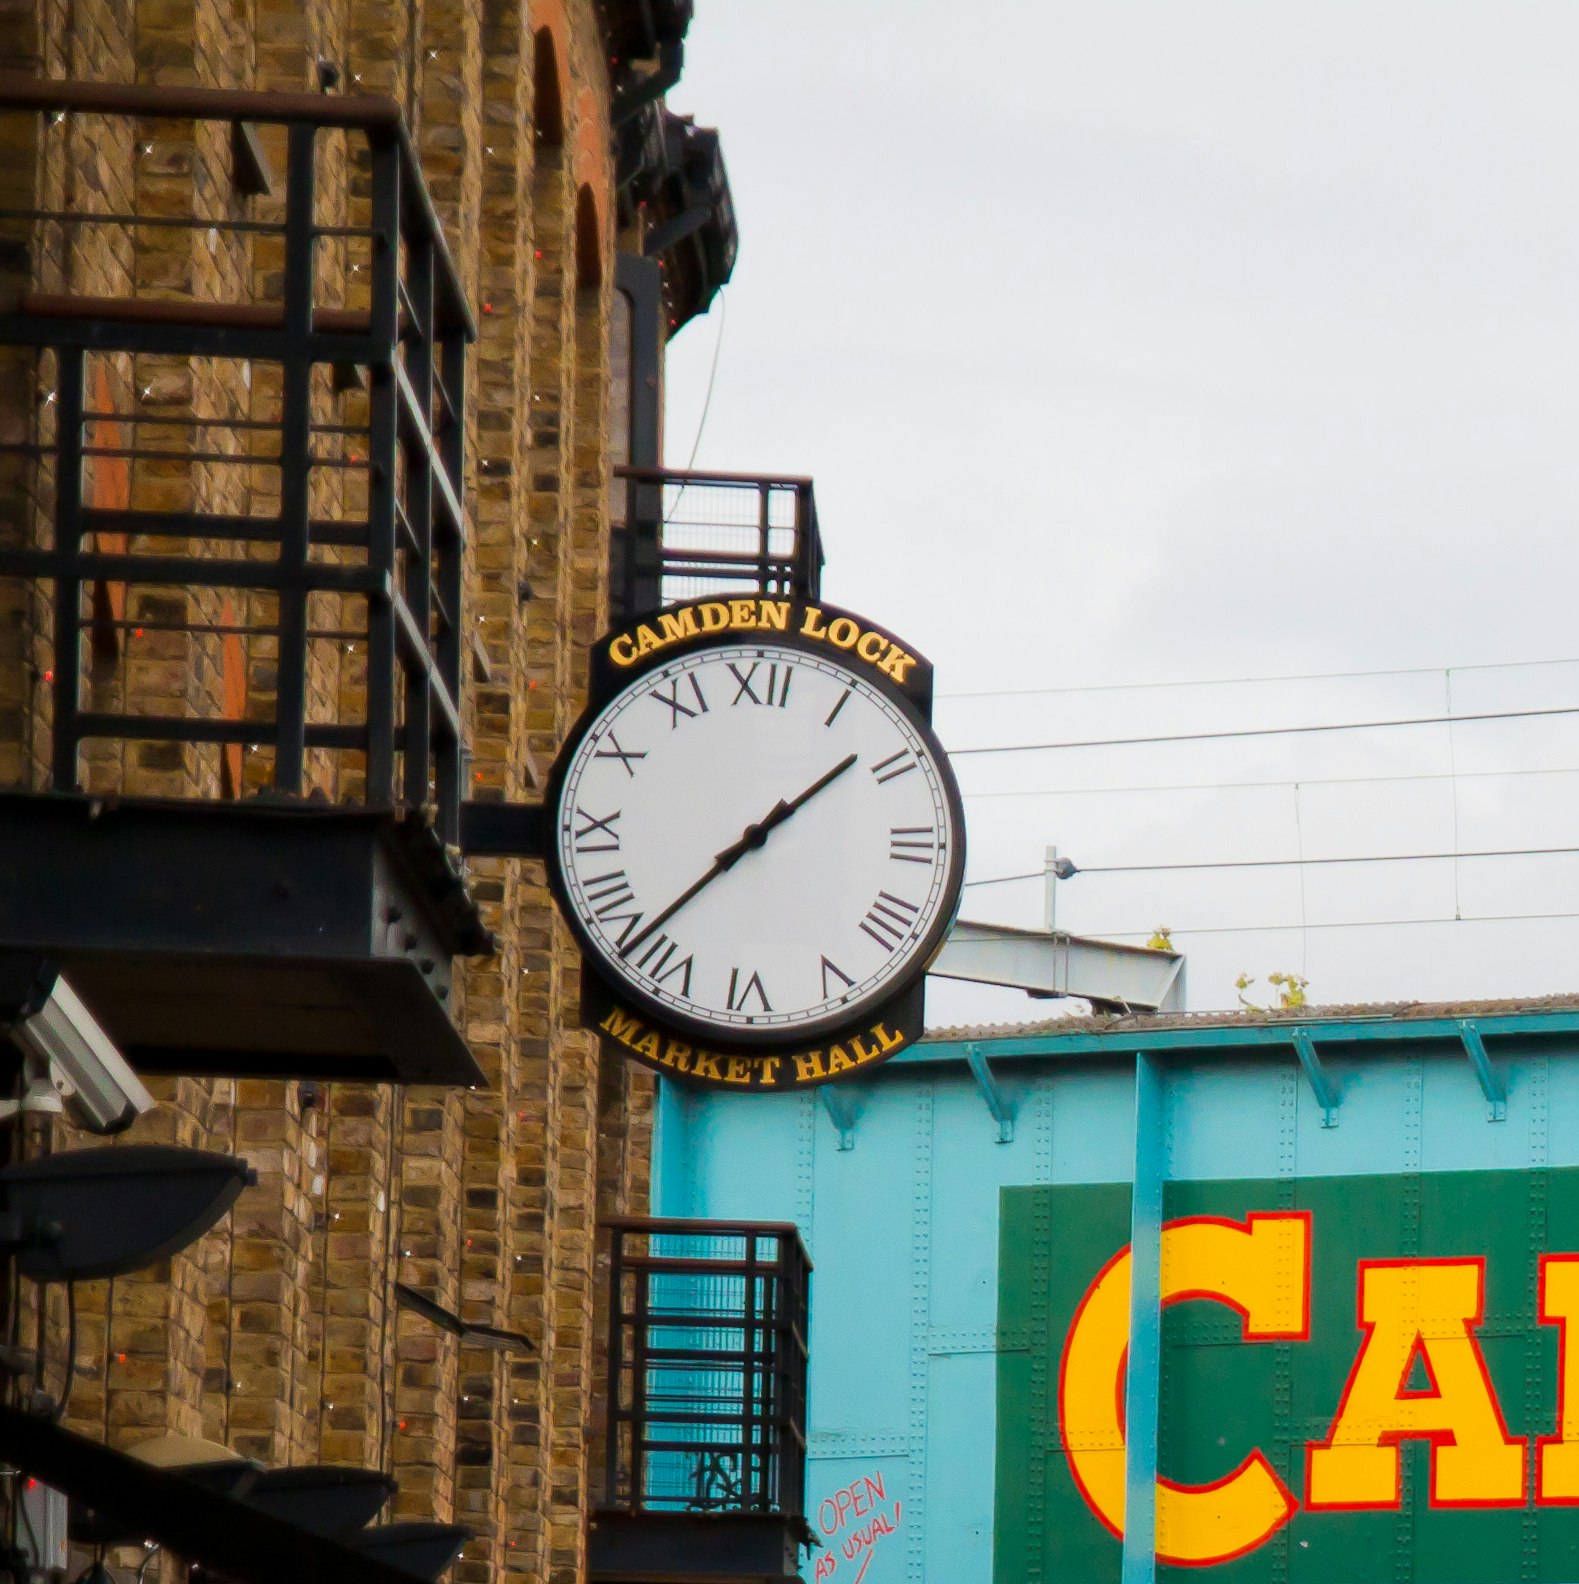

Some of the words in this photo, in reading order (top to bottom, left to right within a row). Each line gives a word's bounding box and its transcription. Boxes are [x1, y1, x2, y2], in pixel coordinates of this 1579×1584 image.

[608, 599, 791, 667] CAMDEN
[800, 605, 918, 685] LOCK
[599, 1006, 782, 1084] MARKET
[795, 1022, 904, 1082] HALL
[819, 1471, 886, 1534] OPEN
[841, 1502, 901, 1559] USUAL!
